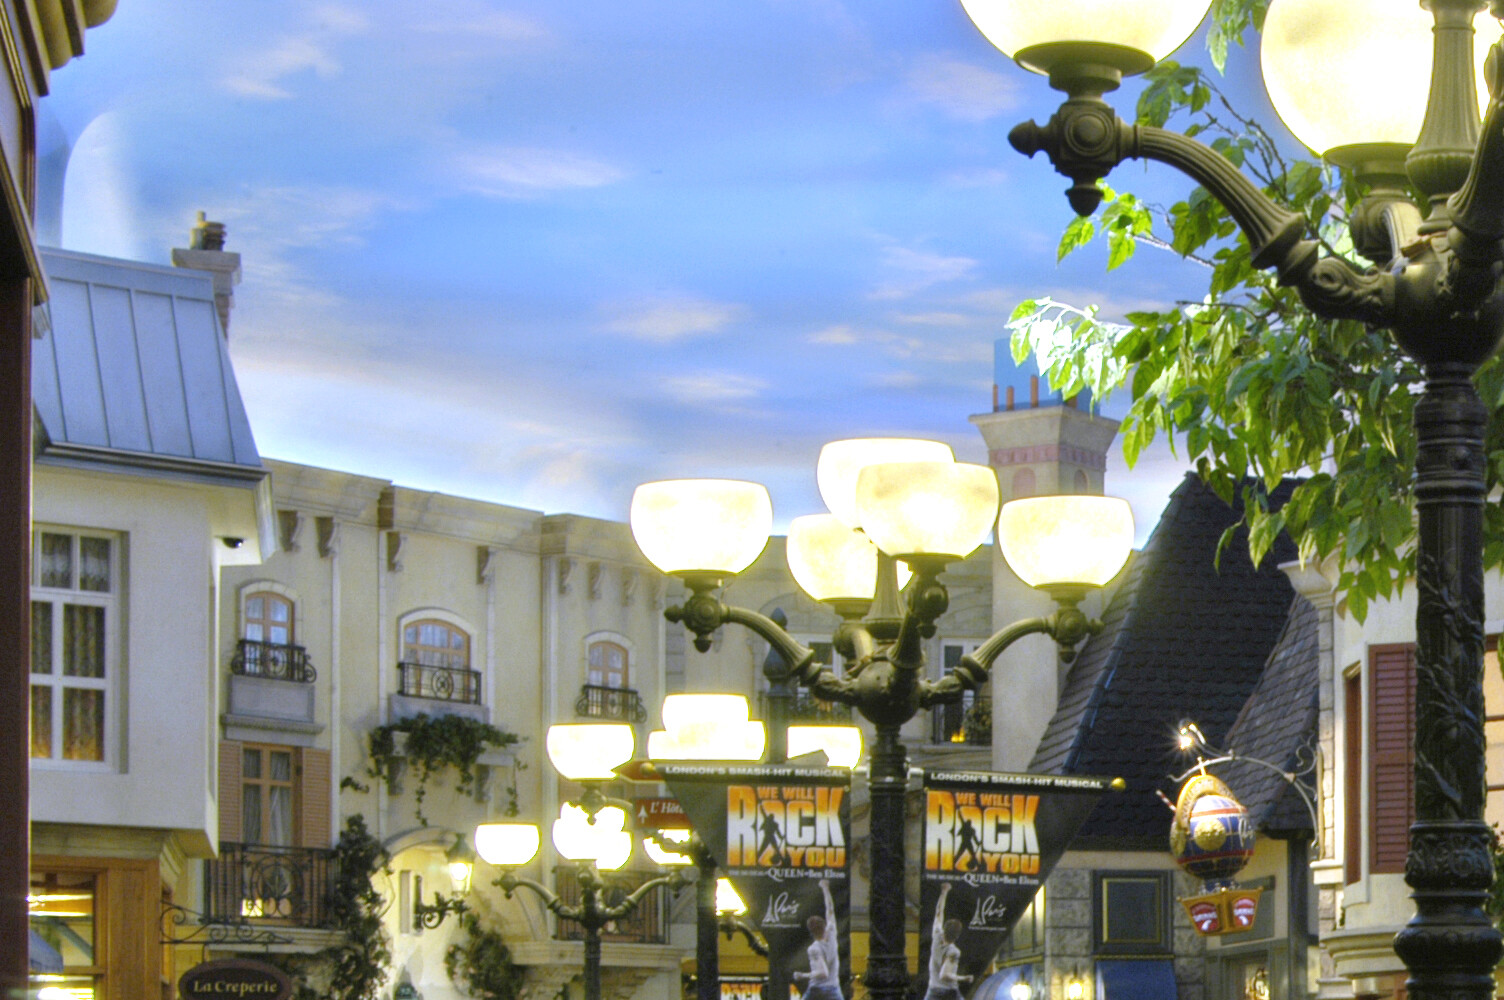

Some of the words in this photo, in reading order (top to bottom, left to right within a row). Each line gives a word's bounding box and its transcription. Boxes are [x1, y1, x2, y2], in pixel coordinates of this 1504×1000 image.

[665, 766, 726, 775] LONDON'S
[728, 767, 792, 776] SMASH-HIT
[795, 768, 846, 777] MUSICAL
[931, 773, 988, 783] LONDON'S
[991, 775, 1052, 786] SMASH-HIT
[1054, 779, 1103, 789] MUSICAL
[757, 786, 779, 800] WE
[782, 786, 814, 800] WILL
[955, 792, 977, 806] WE
[980, 793, 1011, 807] WILL
[727, 785, 845, 867] ROCK
[925, 790, 1040, 872] ROCK
[786, 846, 846, 868] YOU
[981, 853, 1041, 875] YOU
[768, 868, 804, 882] QUEEN
[963, 873, 1000, 887] QUEEN
[193, 981, 212, 993] La
[214, 980, 278, 998] Creperie
